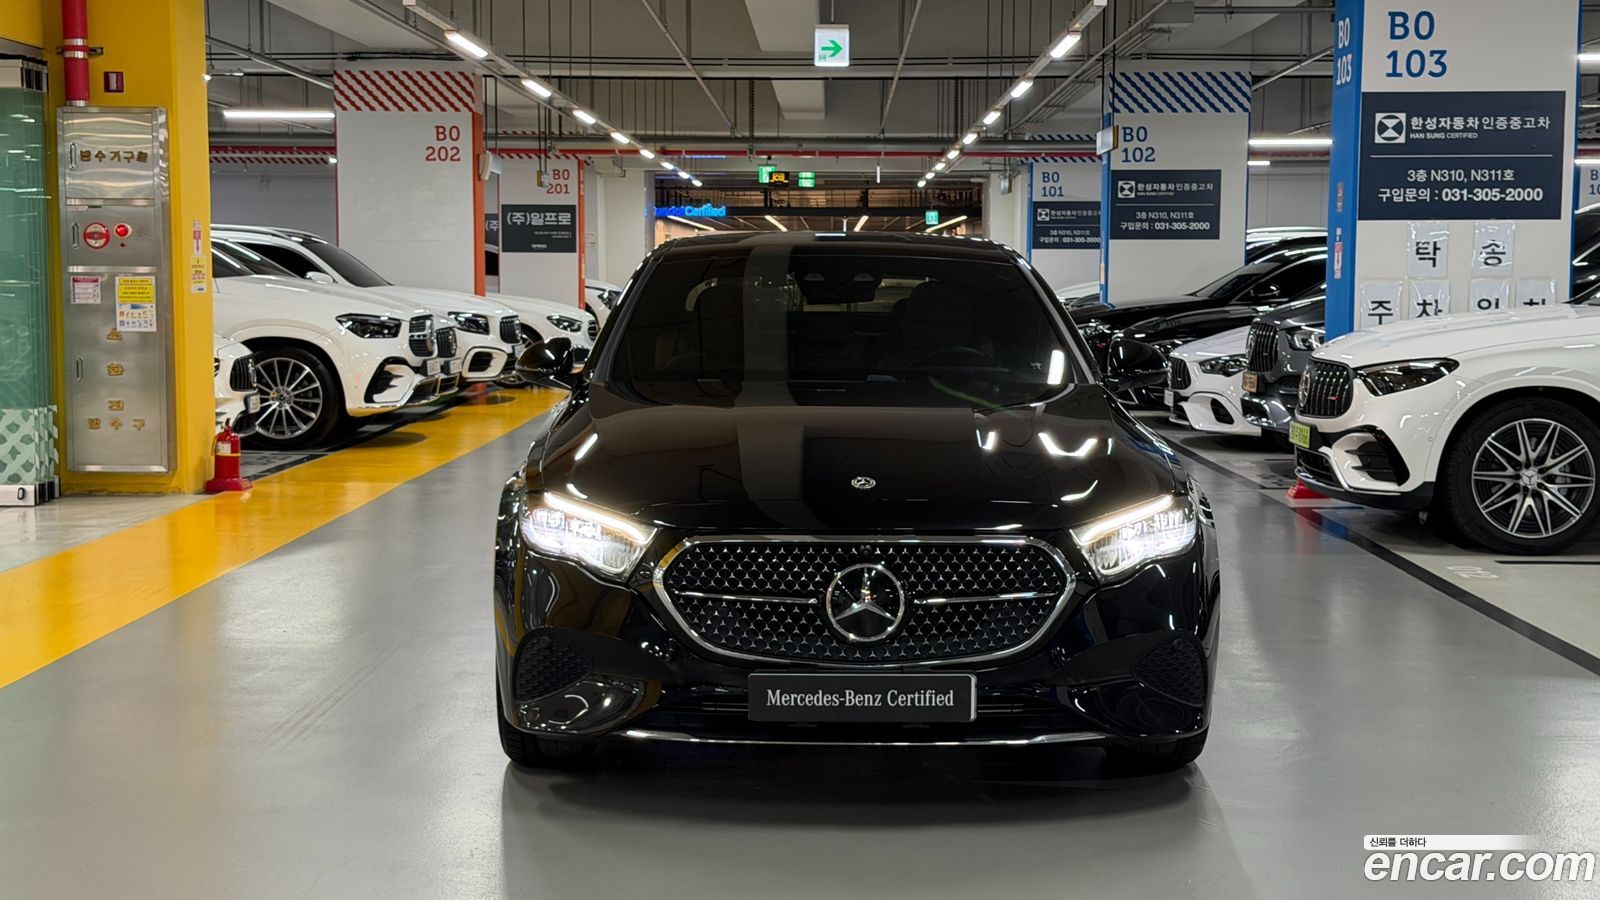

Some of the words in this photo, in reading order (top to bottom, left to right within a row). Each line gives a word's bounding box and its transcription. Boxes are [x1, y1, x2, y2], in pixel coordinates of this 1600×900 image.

[1336, 54, 1352, 86] 103
[1386, 50, 1448, 78] 103
[425, 146, 461, 162] 202
[1122, 147, 1156, 163] 102
[1407, 170, 1428, 182] 3층
[1431, 170, 1468, 183] N310,
[1471, 170, 1515, 182] N311호
[546, 183, 570, 194] 201
[1041, 186, 1064, 197] 101
[1378, 189, 1431, 202] 구입문의
[1442, 189, 1543, 202] 031-305-2000
[507, 212, 571, 225] (주)일프로
[1155, 222, 1210, 230] 031-305-2000
[766, 689, 882, 706] Mercedes-Benz
[887, 689, 954, 706] Certified
